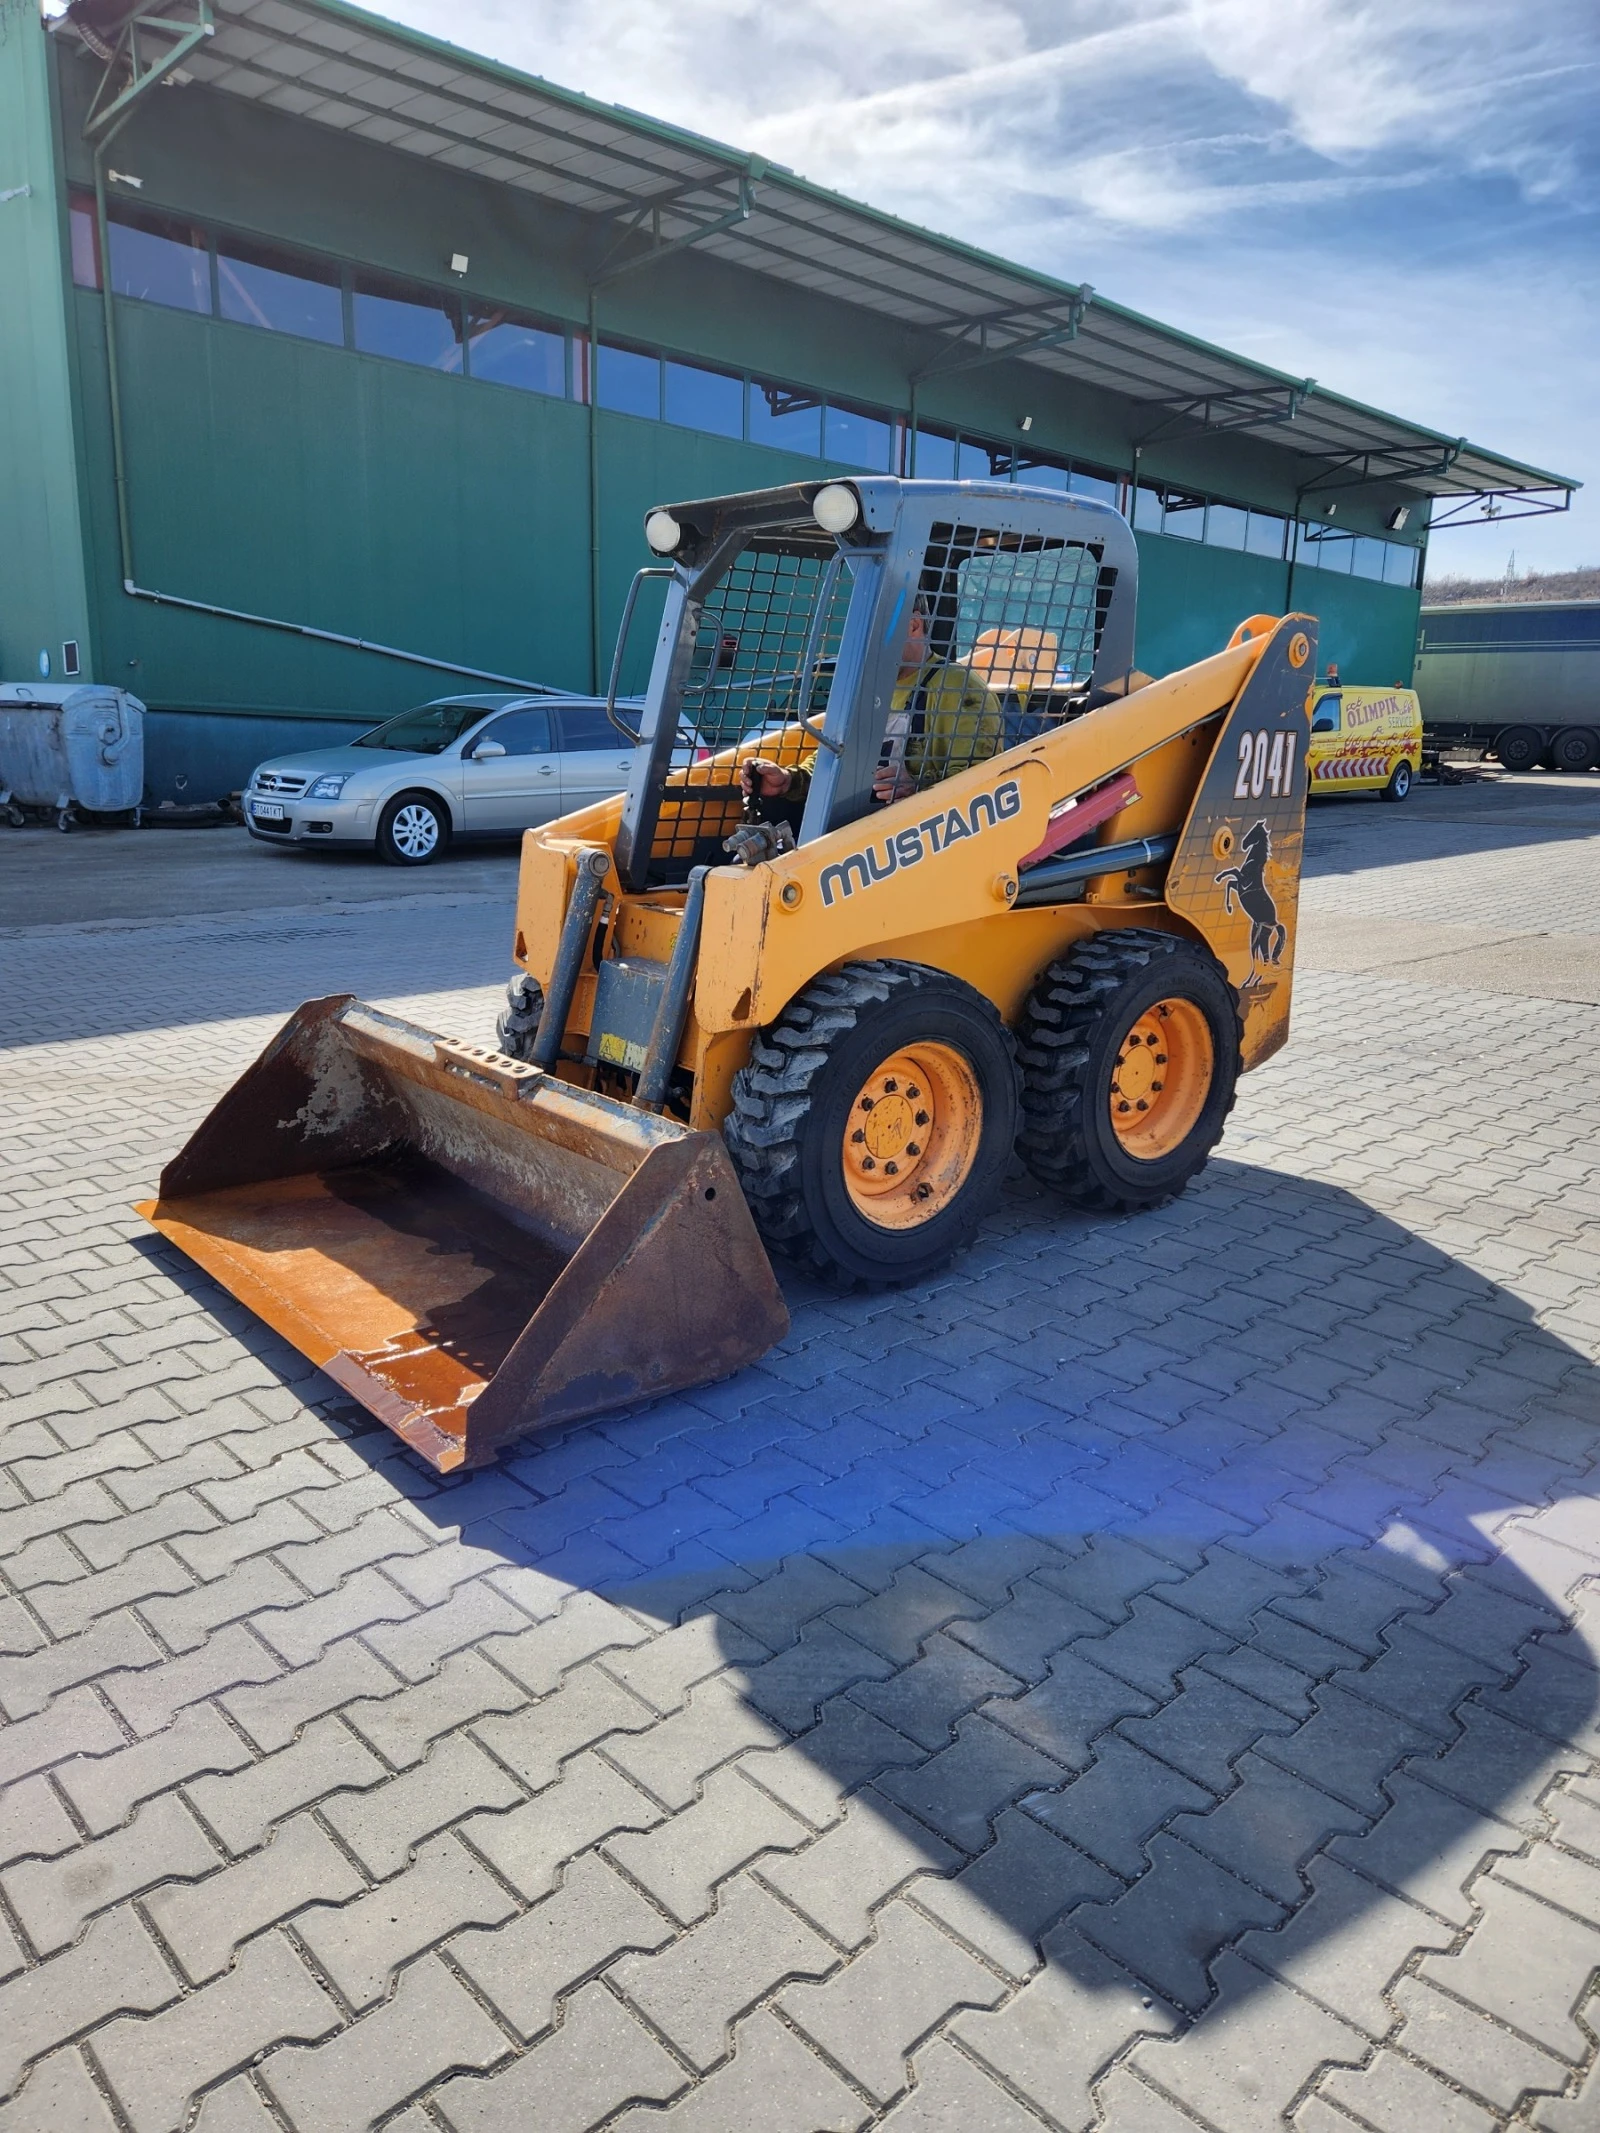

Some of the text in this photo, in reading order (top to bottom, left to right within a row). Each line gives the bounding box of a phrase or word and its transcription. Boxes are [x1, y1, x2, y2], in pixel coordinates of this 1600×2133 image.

[1346, 696, 1400, 728] OLIMPIK
[1388, 716, 1412, 728] SERVICE
[1234, 730, 1297, 799] 2041
[820, 780, 1021, 907] MUSTANG
